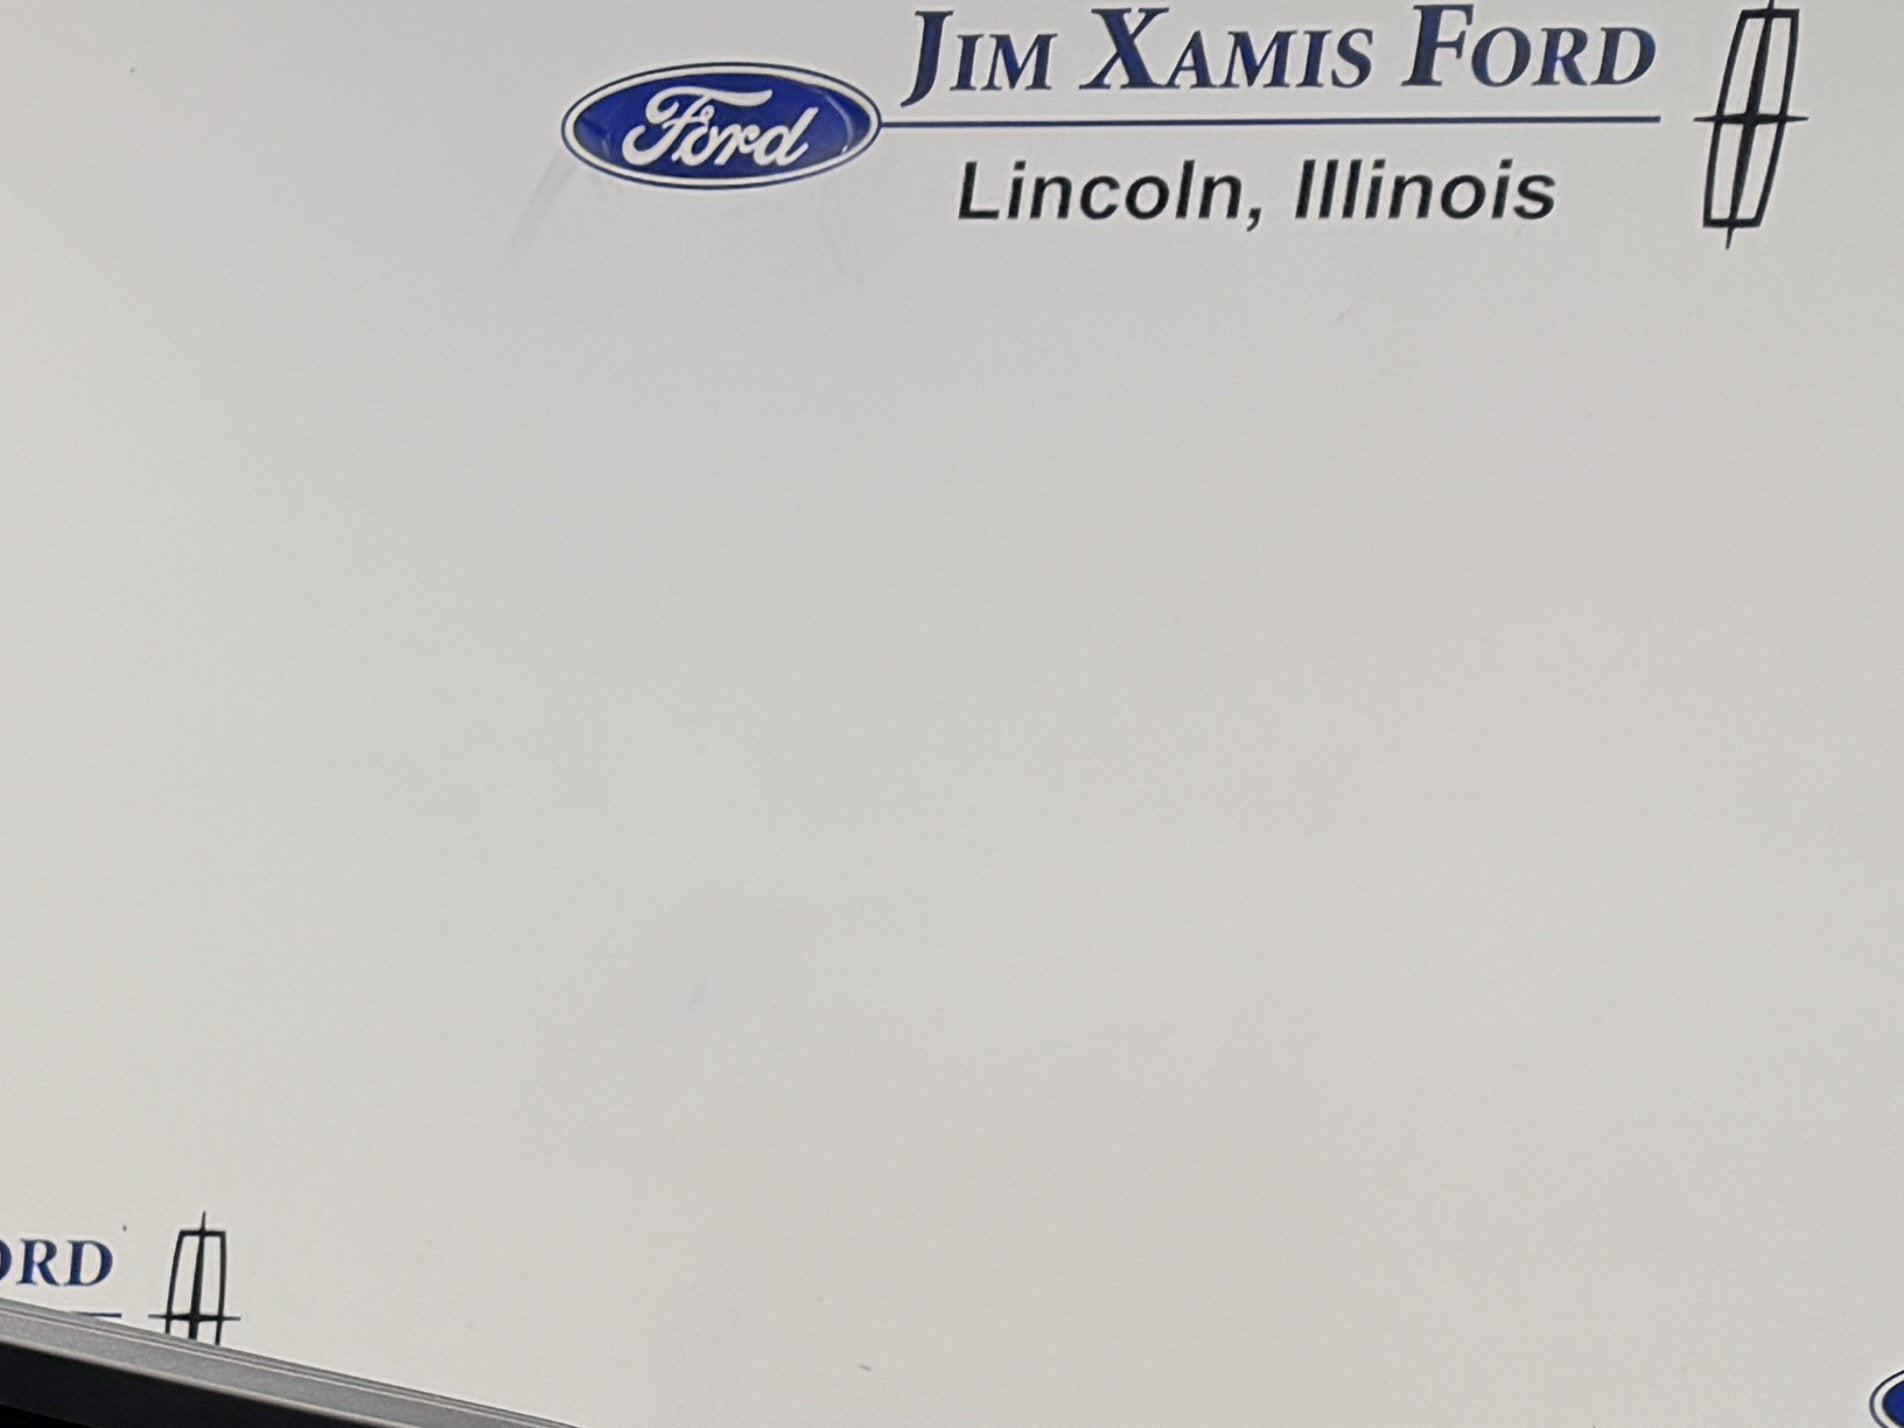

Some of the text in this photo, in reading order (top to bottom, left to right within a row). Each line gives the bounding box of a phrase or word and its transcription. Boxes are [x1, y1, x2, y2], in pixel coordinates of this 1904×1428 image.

[900, 3, 1656, 108] JIM XAMIS FORD
[621, 86, 819, 166] Ford
[958, 158, 1556, 233] Lincoln, Illinois
